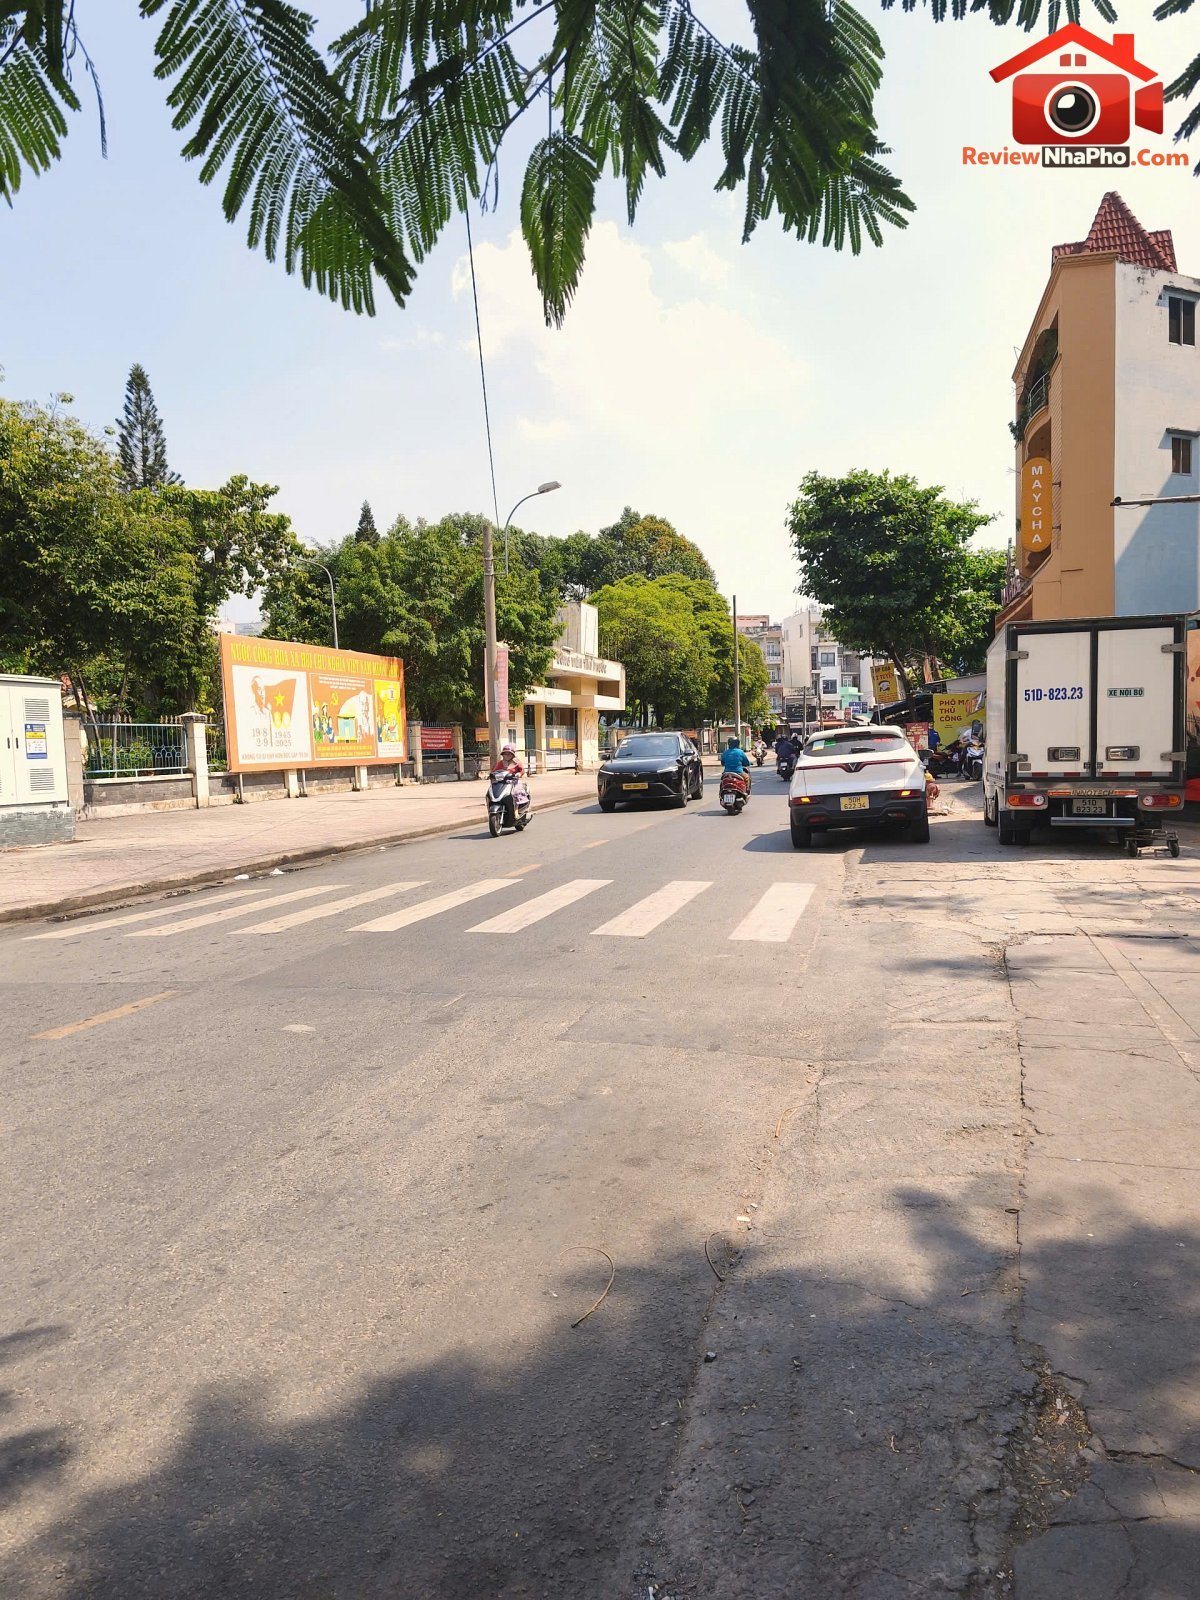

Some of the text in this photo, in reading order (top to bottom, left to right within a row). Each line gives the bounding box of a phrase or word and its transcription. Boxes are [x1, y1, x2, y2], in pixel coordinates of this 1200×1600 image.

[1031, 465, 1043, 543] MAYCHA
[1024, 687, 1083, 702] 51D-823.23
[939, 706, 956, 714] THỦ
